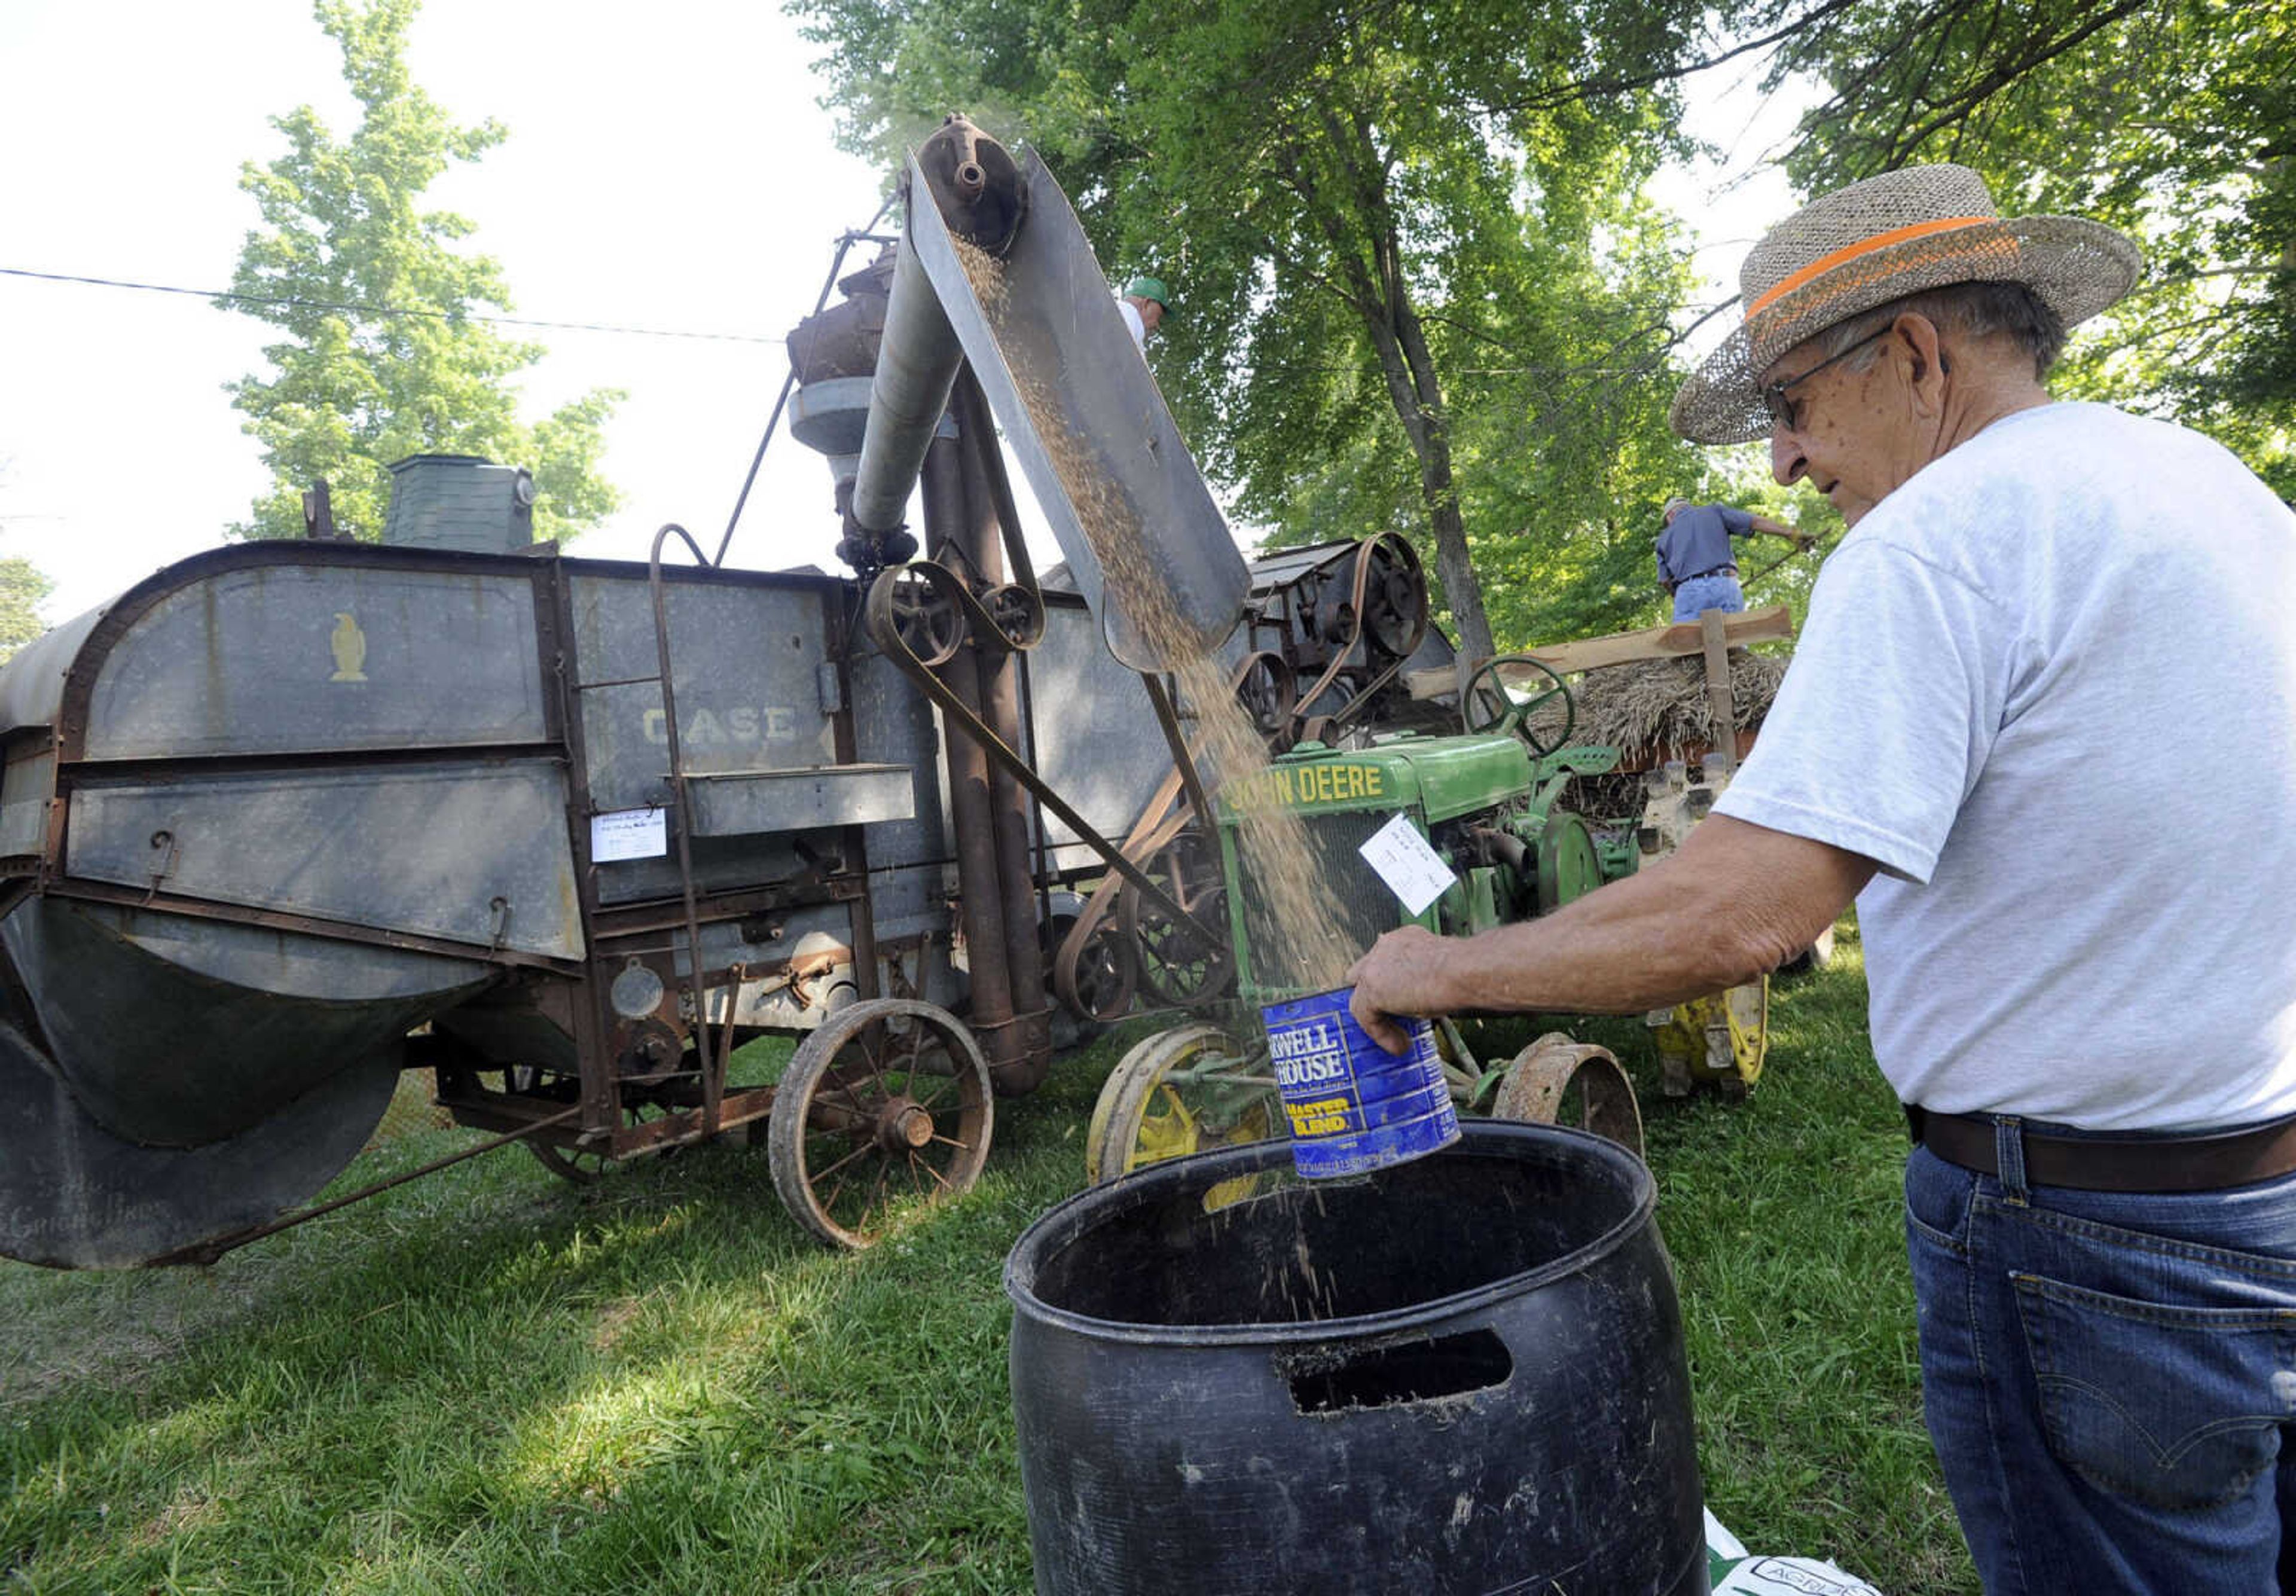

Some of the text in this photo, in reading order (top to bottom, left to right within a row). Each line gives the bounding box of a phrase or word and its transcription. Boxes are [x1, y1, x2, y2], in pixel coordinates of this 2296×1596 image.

[643, 707, 796, 746] CASE
[1298, 765, 1384, 803] DEERE
[1286, 1097, 1351, 1119] MASTER
